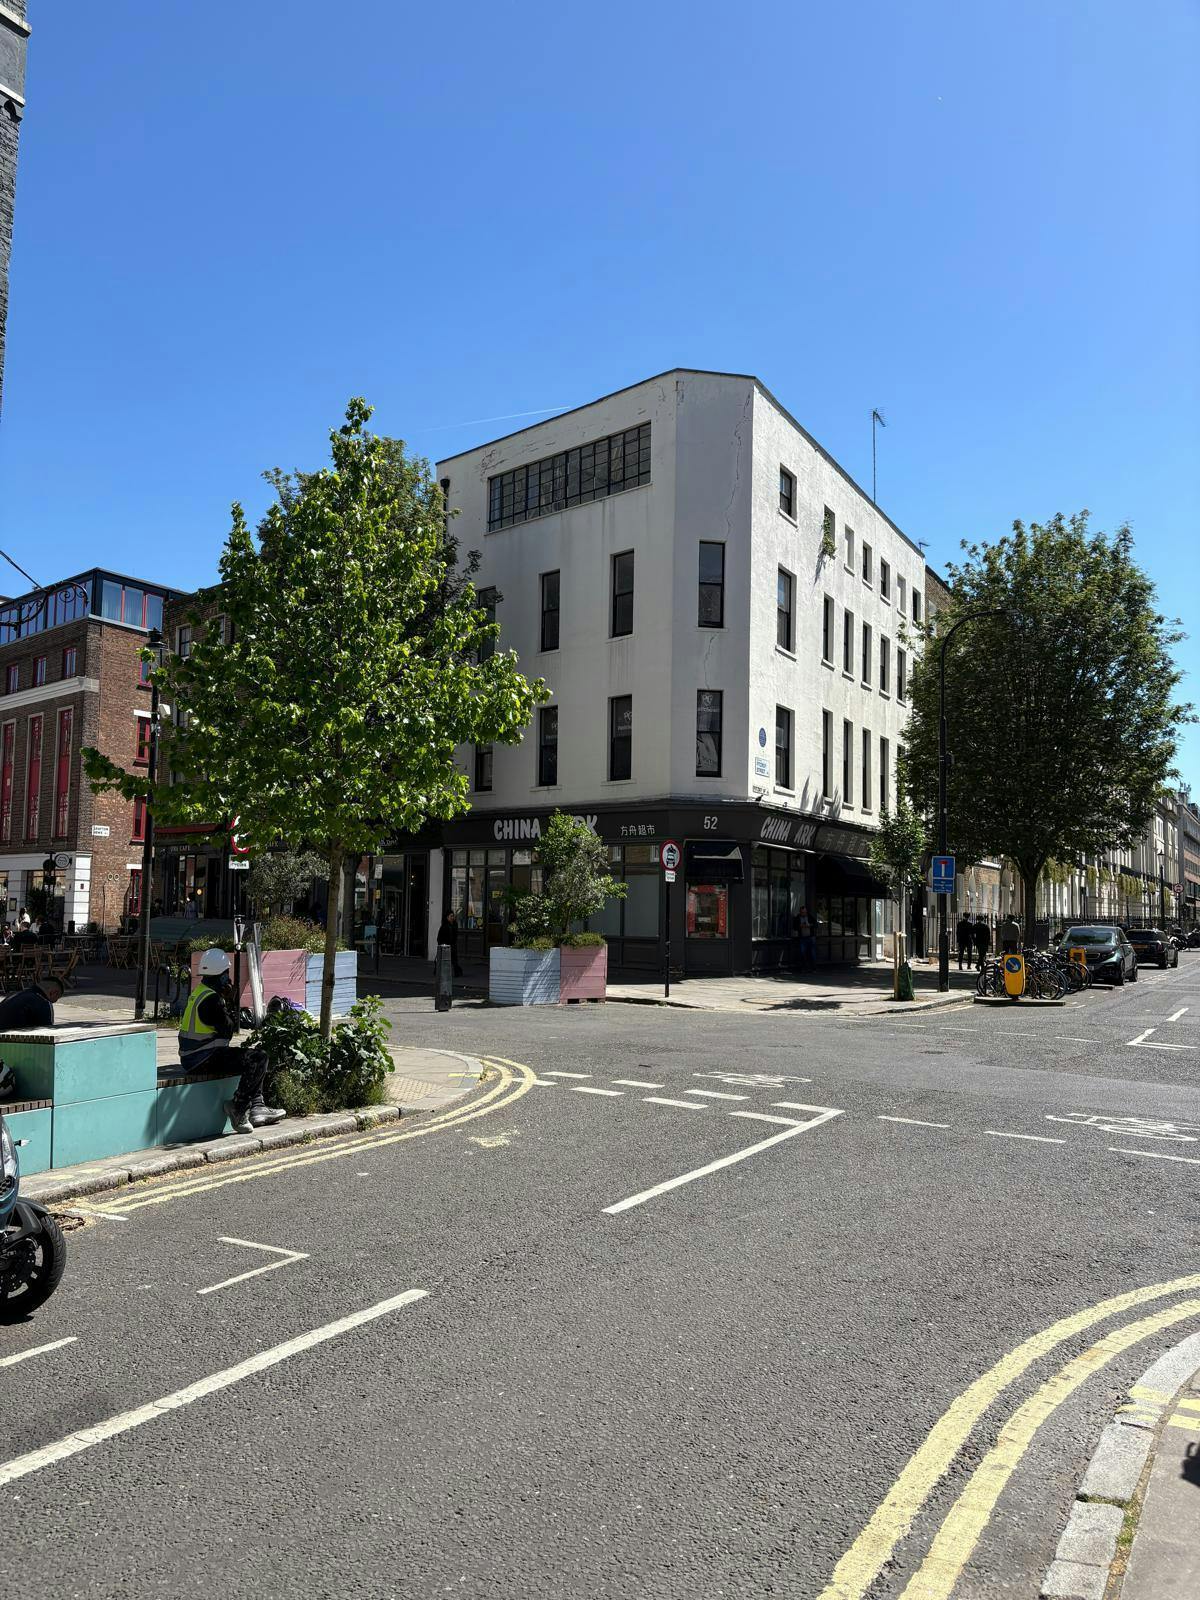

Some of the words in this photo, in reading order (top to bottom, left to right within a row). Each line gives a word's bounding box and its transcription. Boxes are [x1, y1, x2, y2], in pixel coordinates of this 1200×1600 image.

[493, 817, 541, 840] CHINA
[620, 824, 655, 836] 方舟超市
[703, 816, 718, 830] 52
[760, 816, 792, 842] CHINA
[794, 823, 817, 846] ARK
